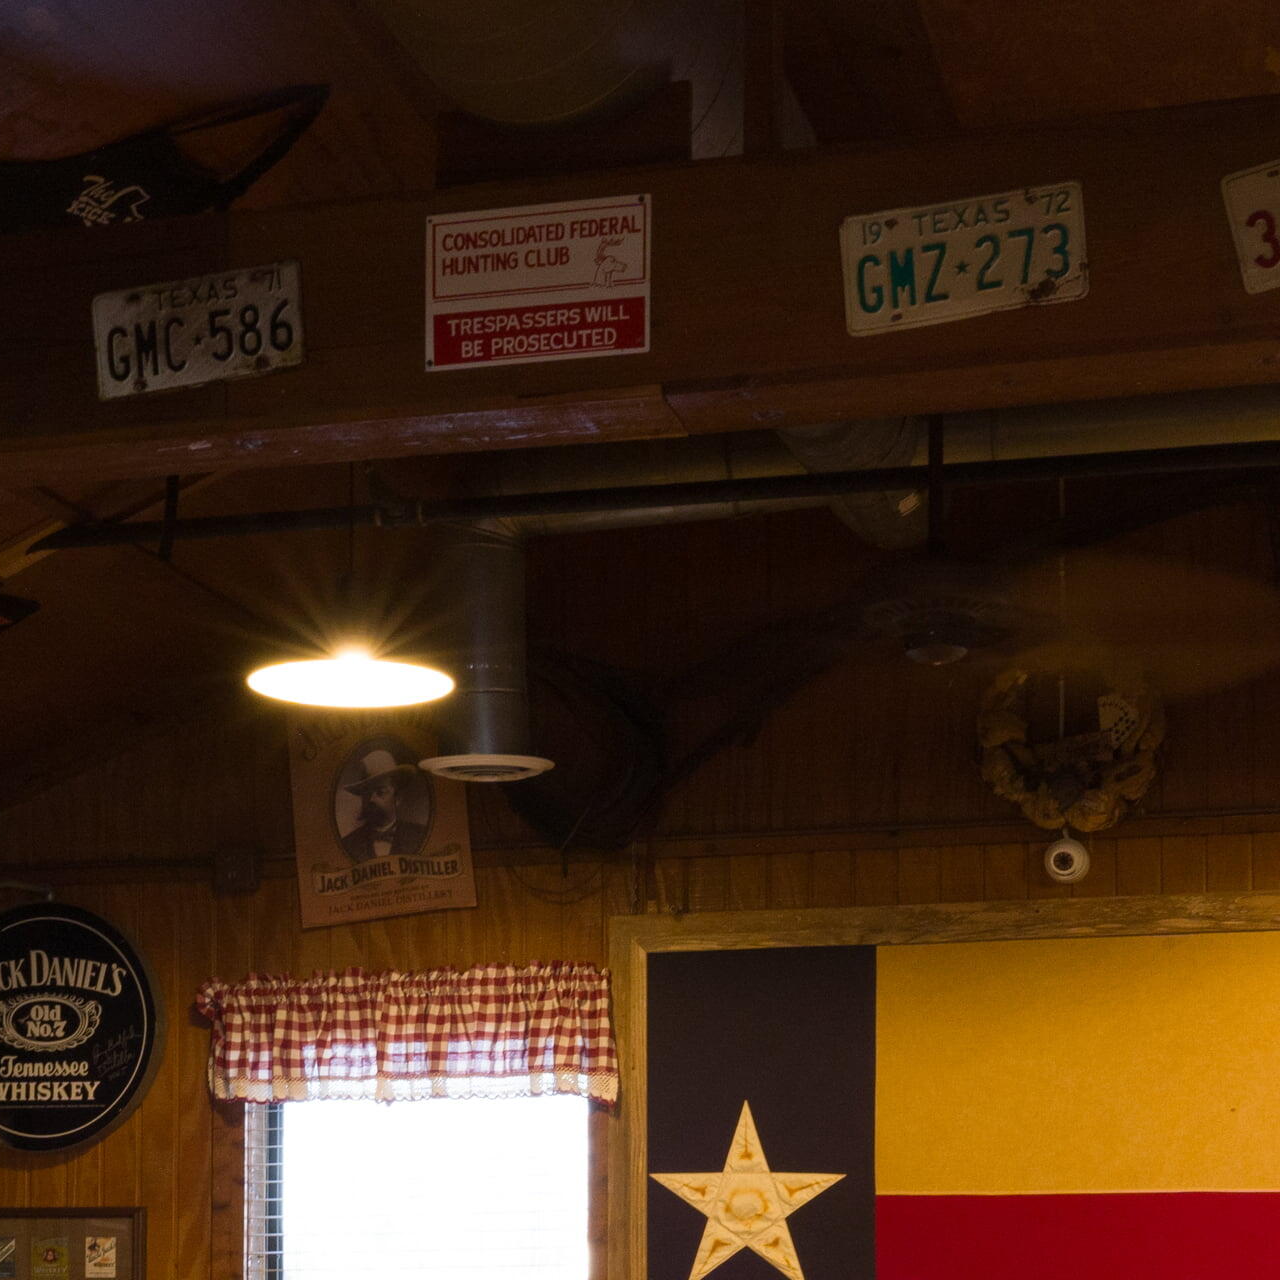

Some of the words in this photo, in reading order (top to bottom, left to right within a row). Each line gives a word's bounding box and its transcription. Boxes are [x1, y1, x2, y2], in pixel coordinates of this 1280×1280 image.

[441, 222, 565, 253] CONSOLIDATED
[570, 214, 642, 240] FEDERAL
[861, 221, 883, 246] 19
[912, 200, 1010, 236] TEXAS
[1040, 190, 1072, 216] 72
[441, 251, 519, 277] HUNTING
[524, 246, 570, 268] CLUB
[857, 241, 950, 313] GMZ
[974, 222, 1070, 292] 273
[154, 278, 239, 311] TEXAS
[261, 269, 284, 294] 71
[447, 307, 582, 338] TRESPASSERS
[584, 303, 631, 324] WILL
[107, 317, 187, 382] GMC
[208, 300, 294, 362] 586
[460, 339, 485, 359] BE
[490, 327, 618, 357] PROSECUTED
[318, 874, 349, 893] JACK
[351, 861, 394, 885] DANIEL
[398, 856, 459, 876] DISTILLER
[30, 949, 127, 997] DANIEL'S
[29, 1004, 62, 1022] Old
